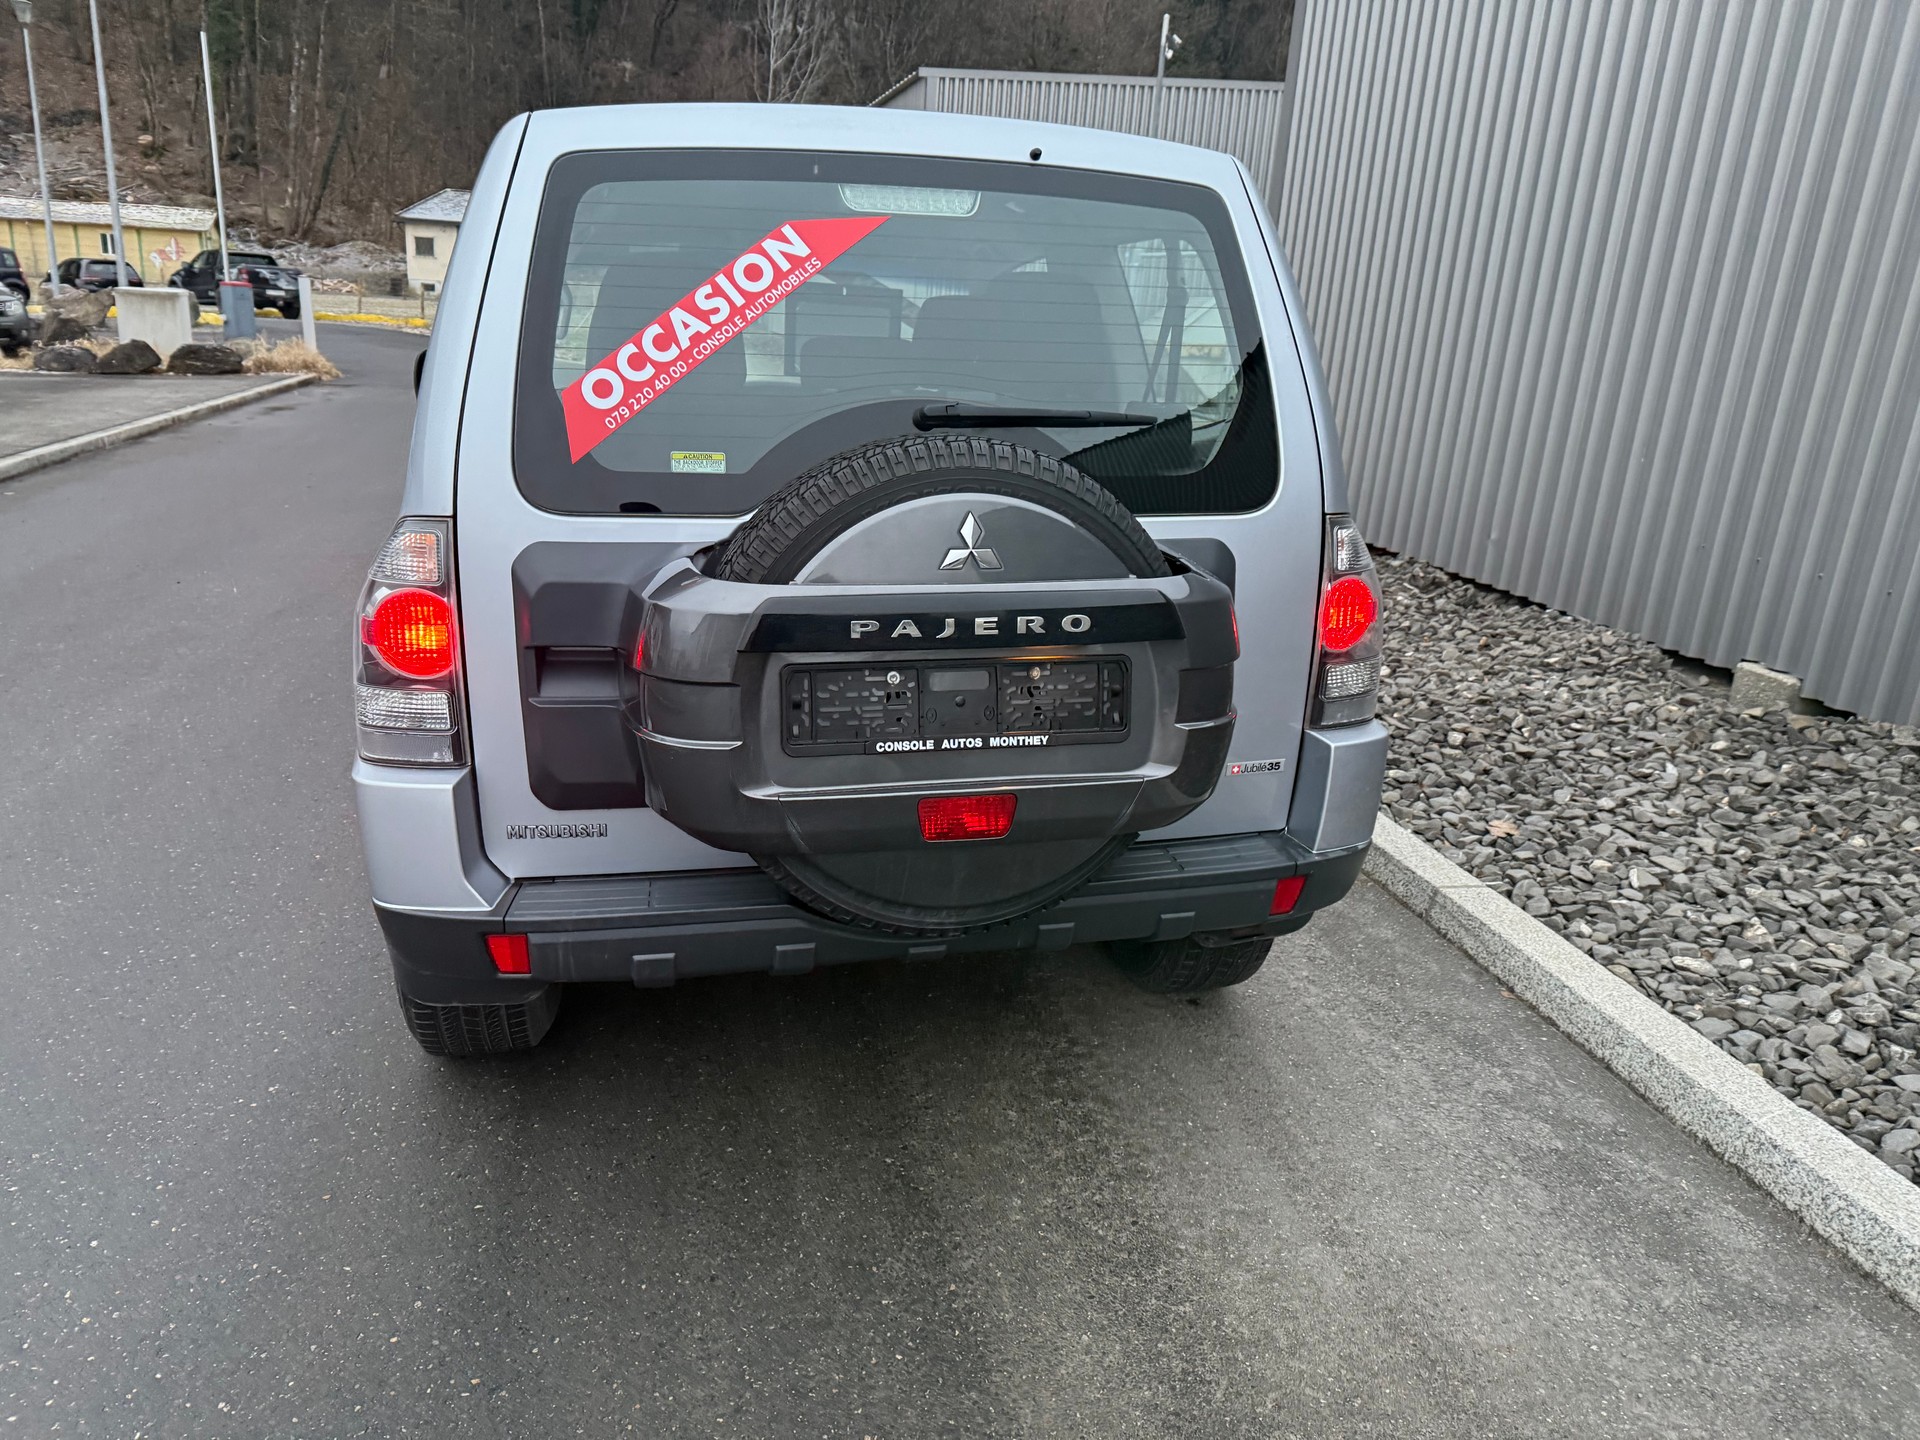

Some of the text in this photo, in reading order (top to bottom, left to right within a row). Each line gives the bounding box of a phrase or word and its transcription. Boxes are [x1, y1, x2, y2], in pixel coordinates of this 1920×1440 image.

[581, 224, 812, 410] OCCASION
[605, 406, 630, 429] 079
[629, 387, 654, 411] 220
[654, 374, 671, 391] 40
[669, 361, 687, 378] 00
[693, 315, 746, 360] CONSOLE
[745, 257, 822, 321] AUTOMOBILES
[850, 614, 1092, 639] PAJERO
[876, 735, 1050, 753] CONSOLE AUTOS MONTHEY
[506, 823, 608, 840] MITSUBISHI
